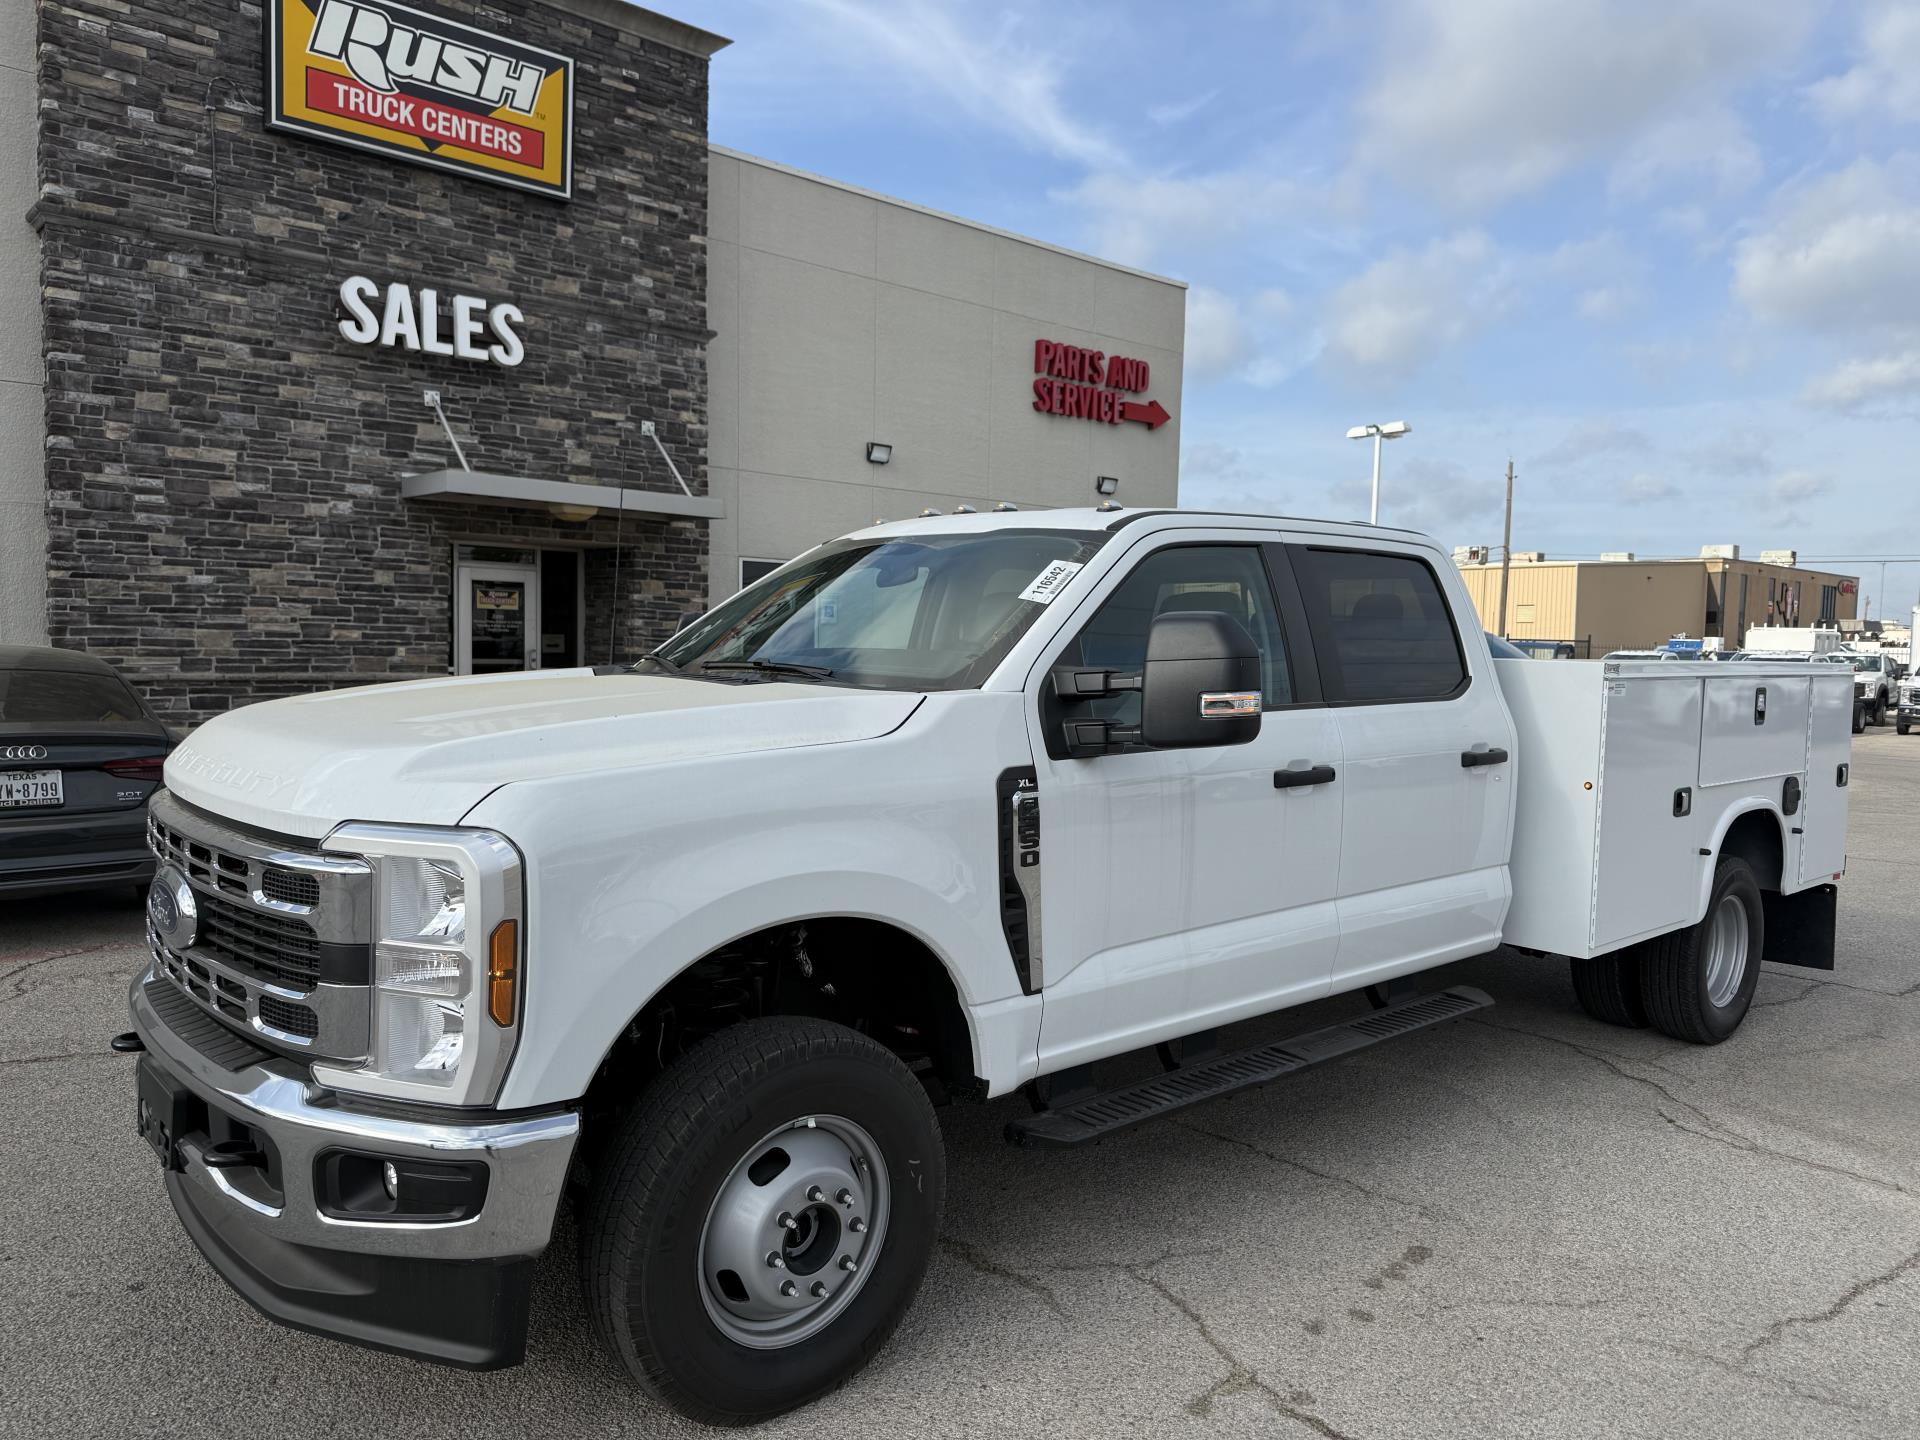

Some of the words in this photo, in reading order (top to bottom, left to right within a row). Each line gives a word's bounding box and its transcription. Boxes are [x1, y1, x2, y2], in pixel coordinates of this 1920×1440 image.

[306, 0, 546, 117] RUSH
[333, 82, 416, 127] TRUCK
[422, 107, 523, 156] CENTERS
[338, 275, 525, 367] SALES
[1034, 339, 1105, 384] PARTS
[1105, 355, 1150, 393] AND
[1033, 377, 1125, 425] SERVICE
[1032, 566, 1066, 594] 116542
[6, 773, 37, 781] TEXAS
[22, 782, 58, 798] 8799
[1018, 779, 1034, 788] XL
[20, 798, 58, 807] Dallas
